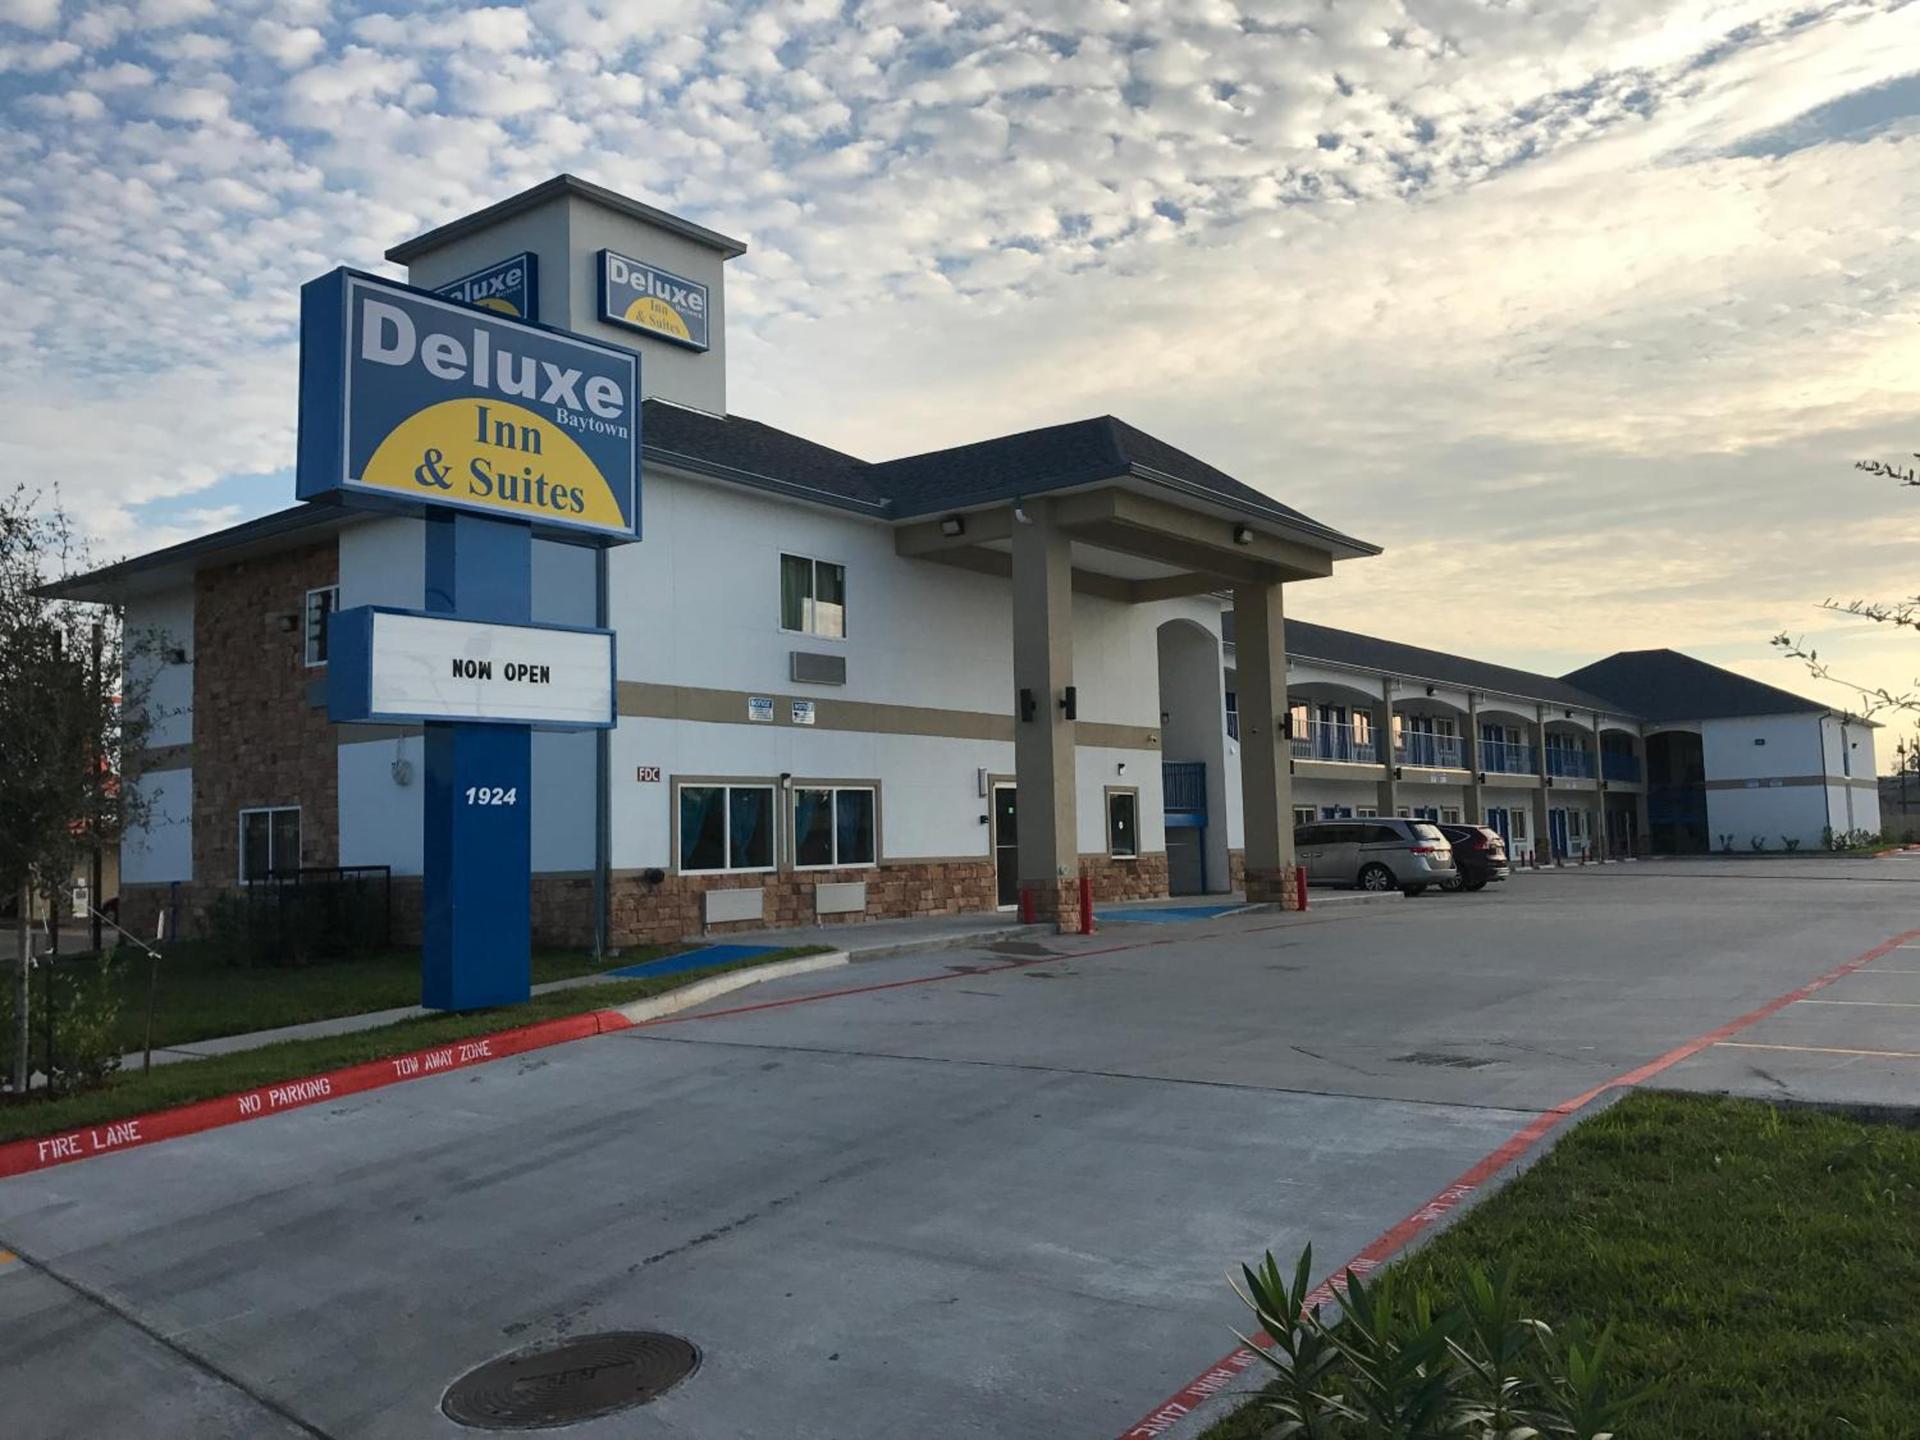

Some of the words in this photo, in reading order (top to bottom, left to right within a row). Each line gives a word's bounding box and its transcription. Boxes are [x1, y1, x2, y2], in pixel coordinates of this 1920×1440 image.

[610, 258, 703, 311] Deluxe
[650, 300, 668, 316] Inn
[361, 299, 624, 419] Deluxe
[474, 405, 542, 455] Inn
[556, 407, 628, 439] Baytown
[414, 448, 453, 490] &
[469, 458, 585, 514] Suites
[452, 659, 492, 680] NOW
[504, 663, 550, 683] OPEN
[639, 767, 660, 782] FDC
[465, 787, 517, 805] 1924
[392, 1058, 419, 1077] TOW
[425, 1048, 453, 1071] AWAY
[459, 1040, 493, 1063] ZONE
[238, 1096, 262, 1114] NO
[270, 1078, 331, 1107] PARKING
[38, 1134, 82, 1162] FIRE
[93, 1120, 142, 1149] LANE
